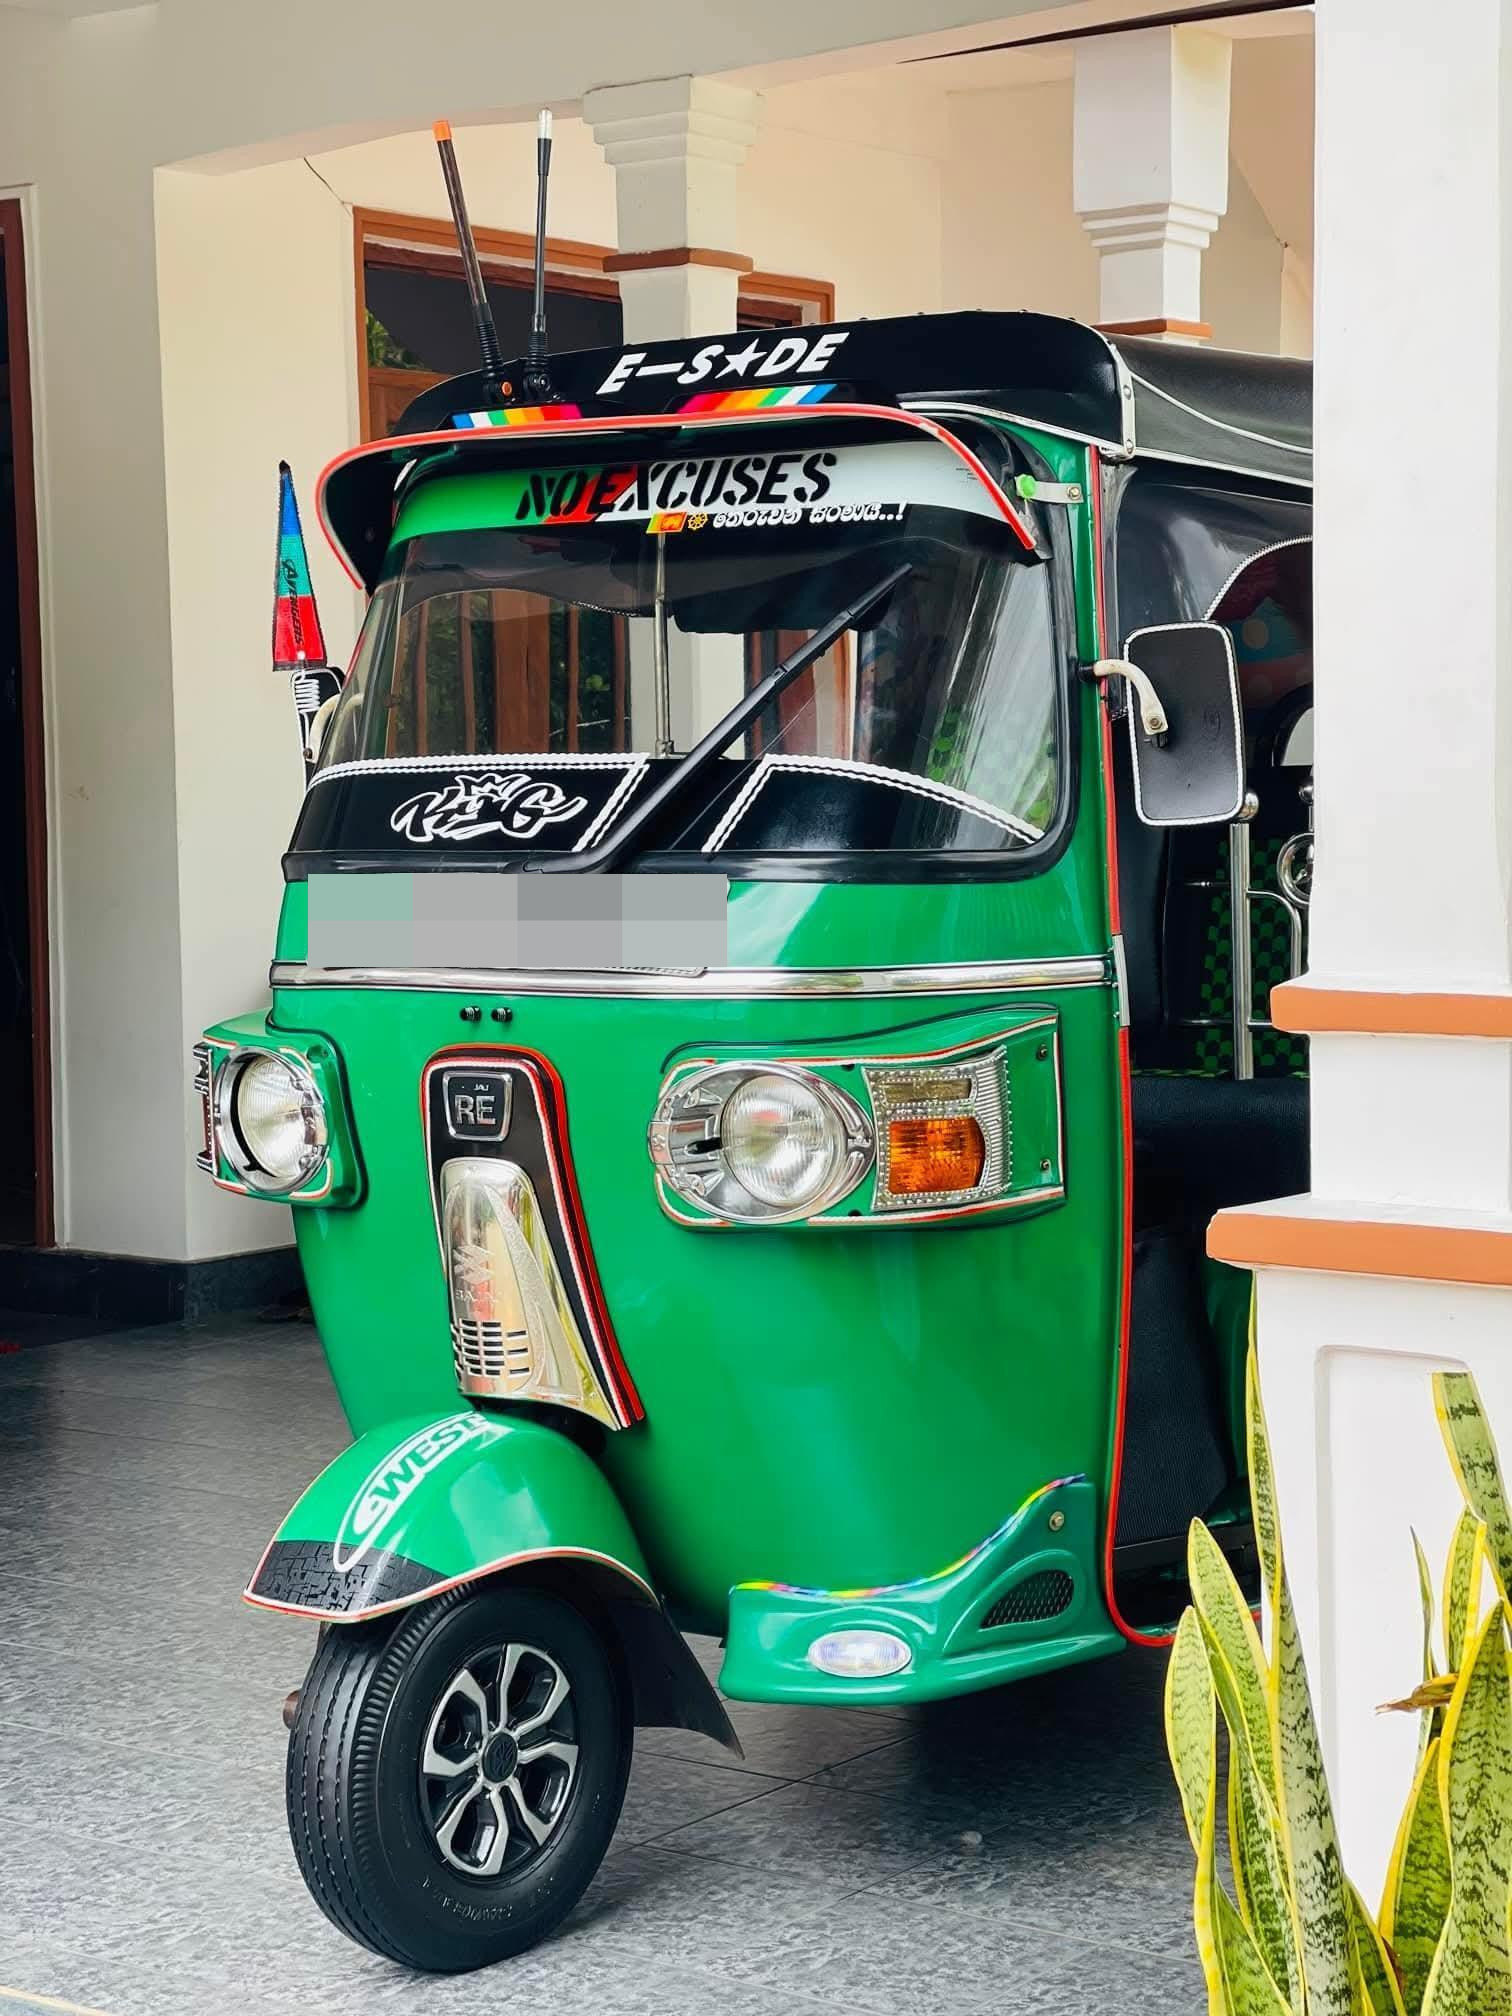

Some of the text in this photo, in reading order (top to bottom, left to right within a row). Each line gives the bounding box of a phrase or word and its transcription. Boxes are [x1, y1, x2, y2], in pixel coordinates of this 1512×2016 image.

[515, 453, 837, 520] NO EXCUSES
[455, 1094, 496, 1124] RE
